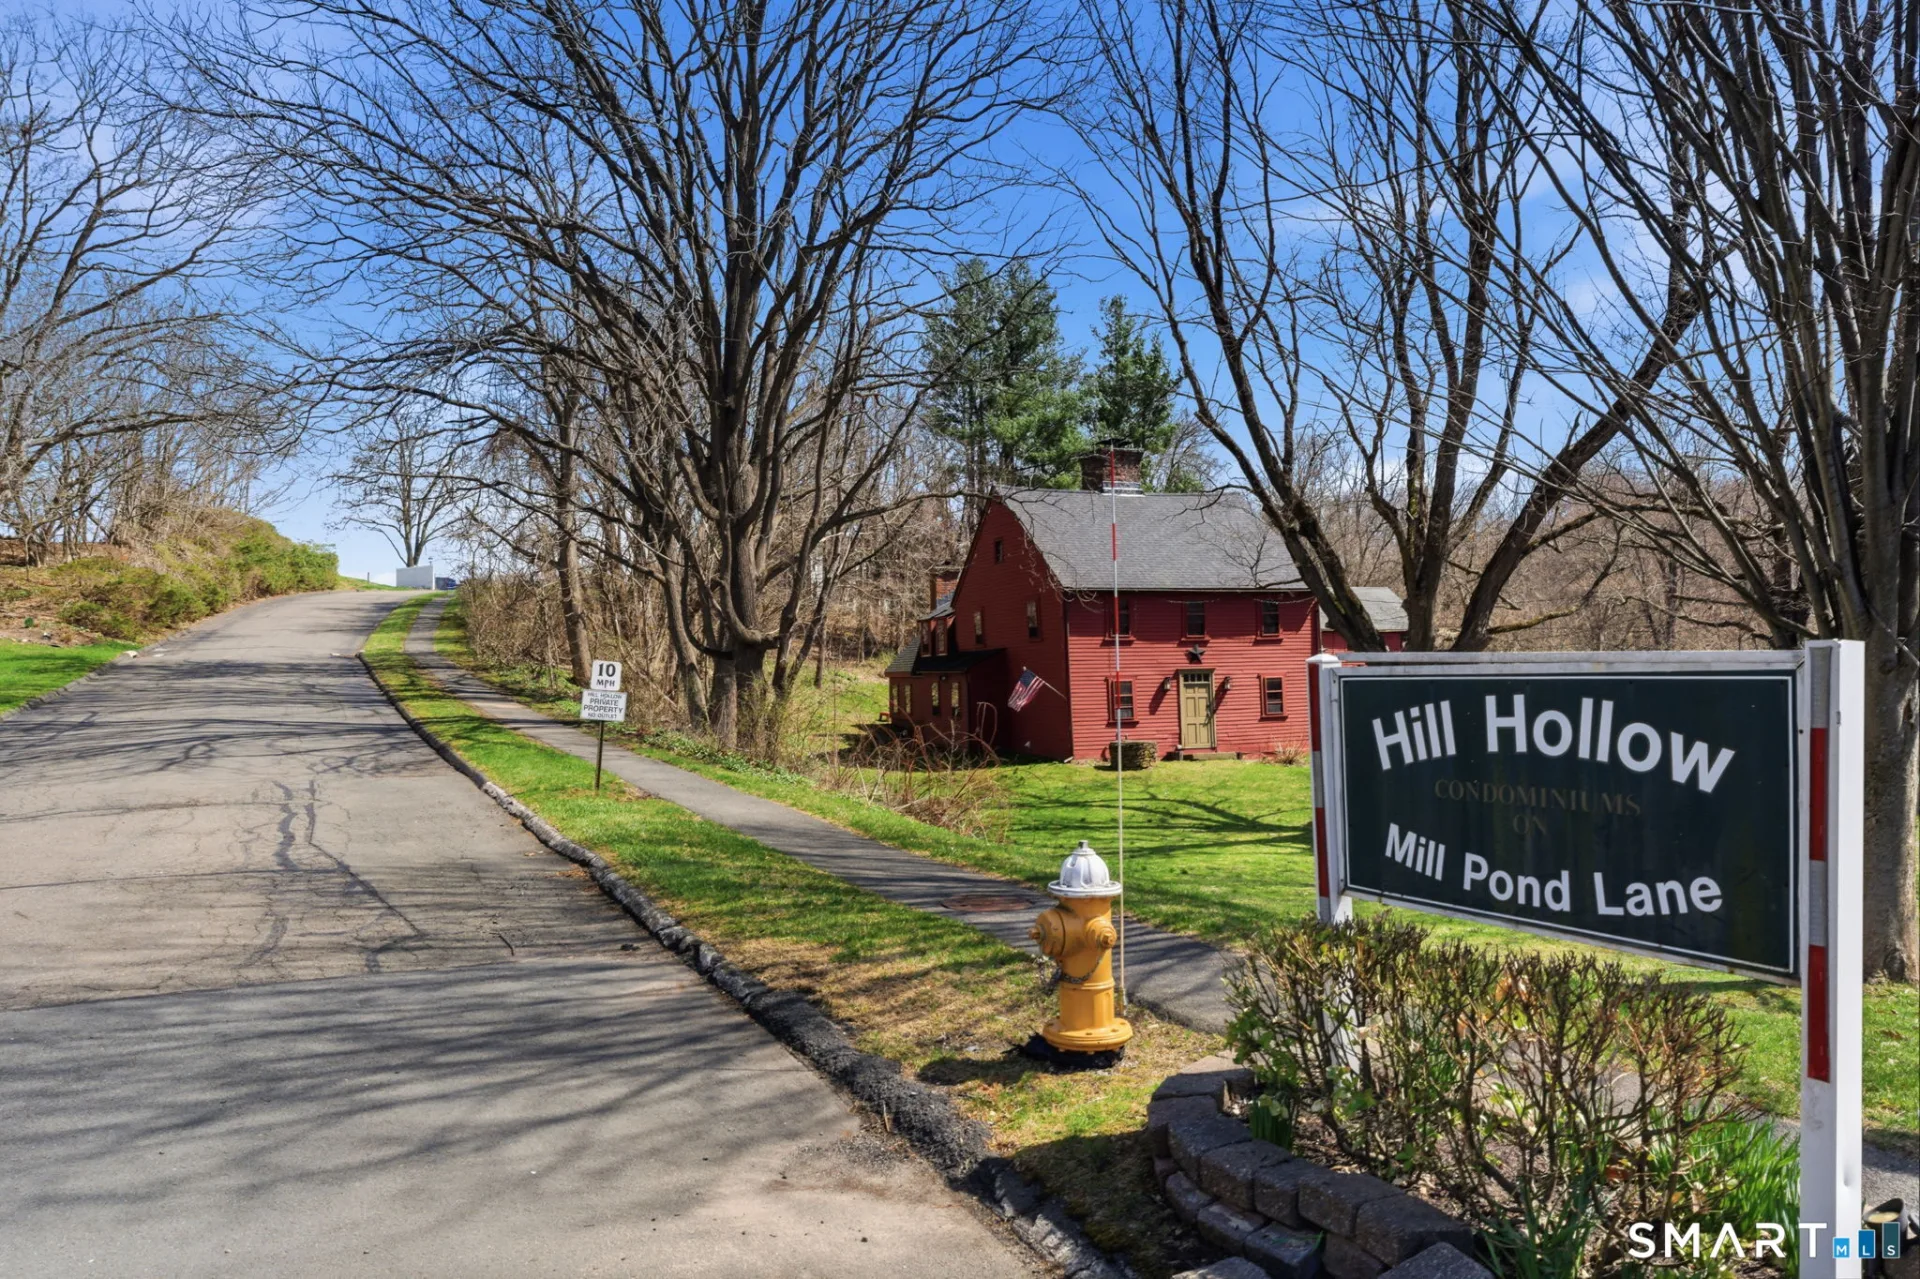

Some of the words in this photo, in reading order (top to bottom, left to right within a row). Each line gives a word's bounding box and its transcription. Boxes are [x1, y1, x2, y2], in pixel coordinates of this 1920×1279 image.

[598, 663, 616, 677] 10
[596, 679, 615, 688] MPH
[583, 704, 624, 714] PROPERTY
[590, 698, 619, 706] PRIVATE
[1372, 700, 1457, 771] Hill
[1485, 694, 1736, 794] Hollow
[1434, 779, 1641, 816] CONDOMINIUMS
[1384, 822, 1446, 882] Mill
[1463, 852, 1571, 912] Pond
[1594, 871, 1723, 917] Lane
